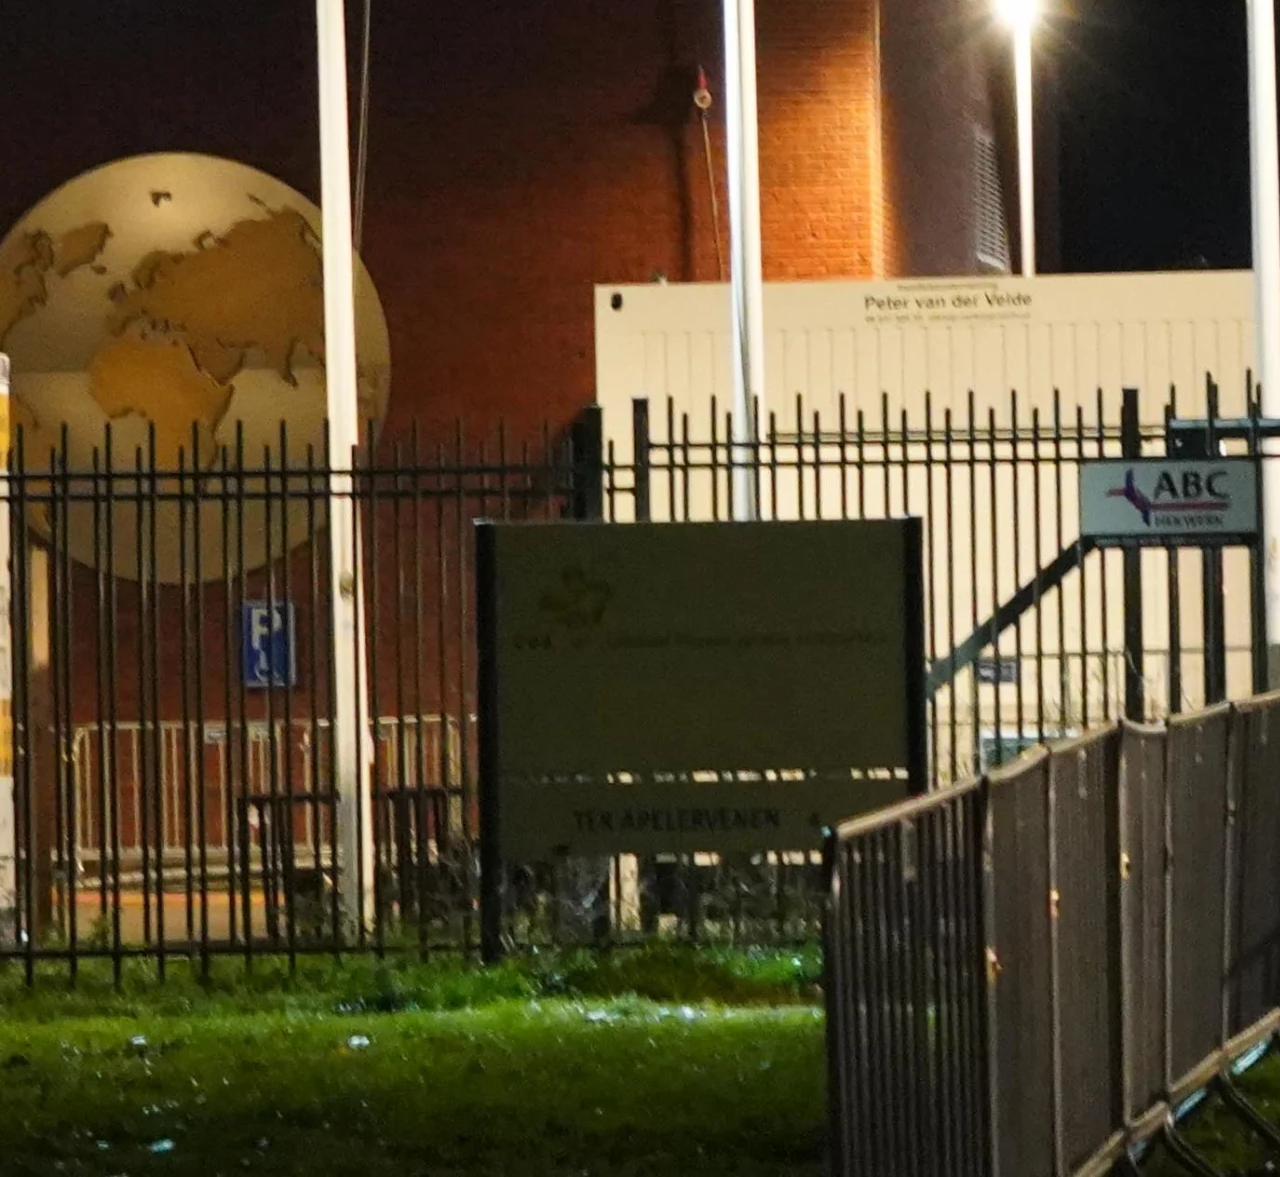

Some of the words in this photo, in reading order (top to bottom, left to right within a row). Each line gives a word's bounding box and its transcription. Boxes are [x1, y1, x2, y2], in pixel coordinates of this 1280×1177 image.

[864, 295, 908, 310] Peter
[915, 297, 946, 309] van
[951, 293, 978, 308] der
[984, 291, 1032, 307] Velde
[1154, 470, 1230, 499] ABC
[252, 608, 283, 650] P
